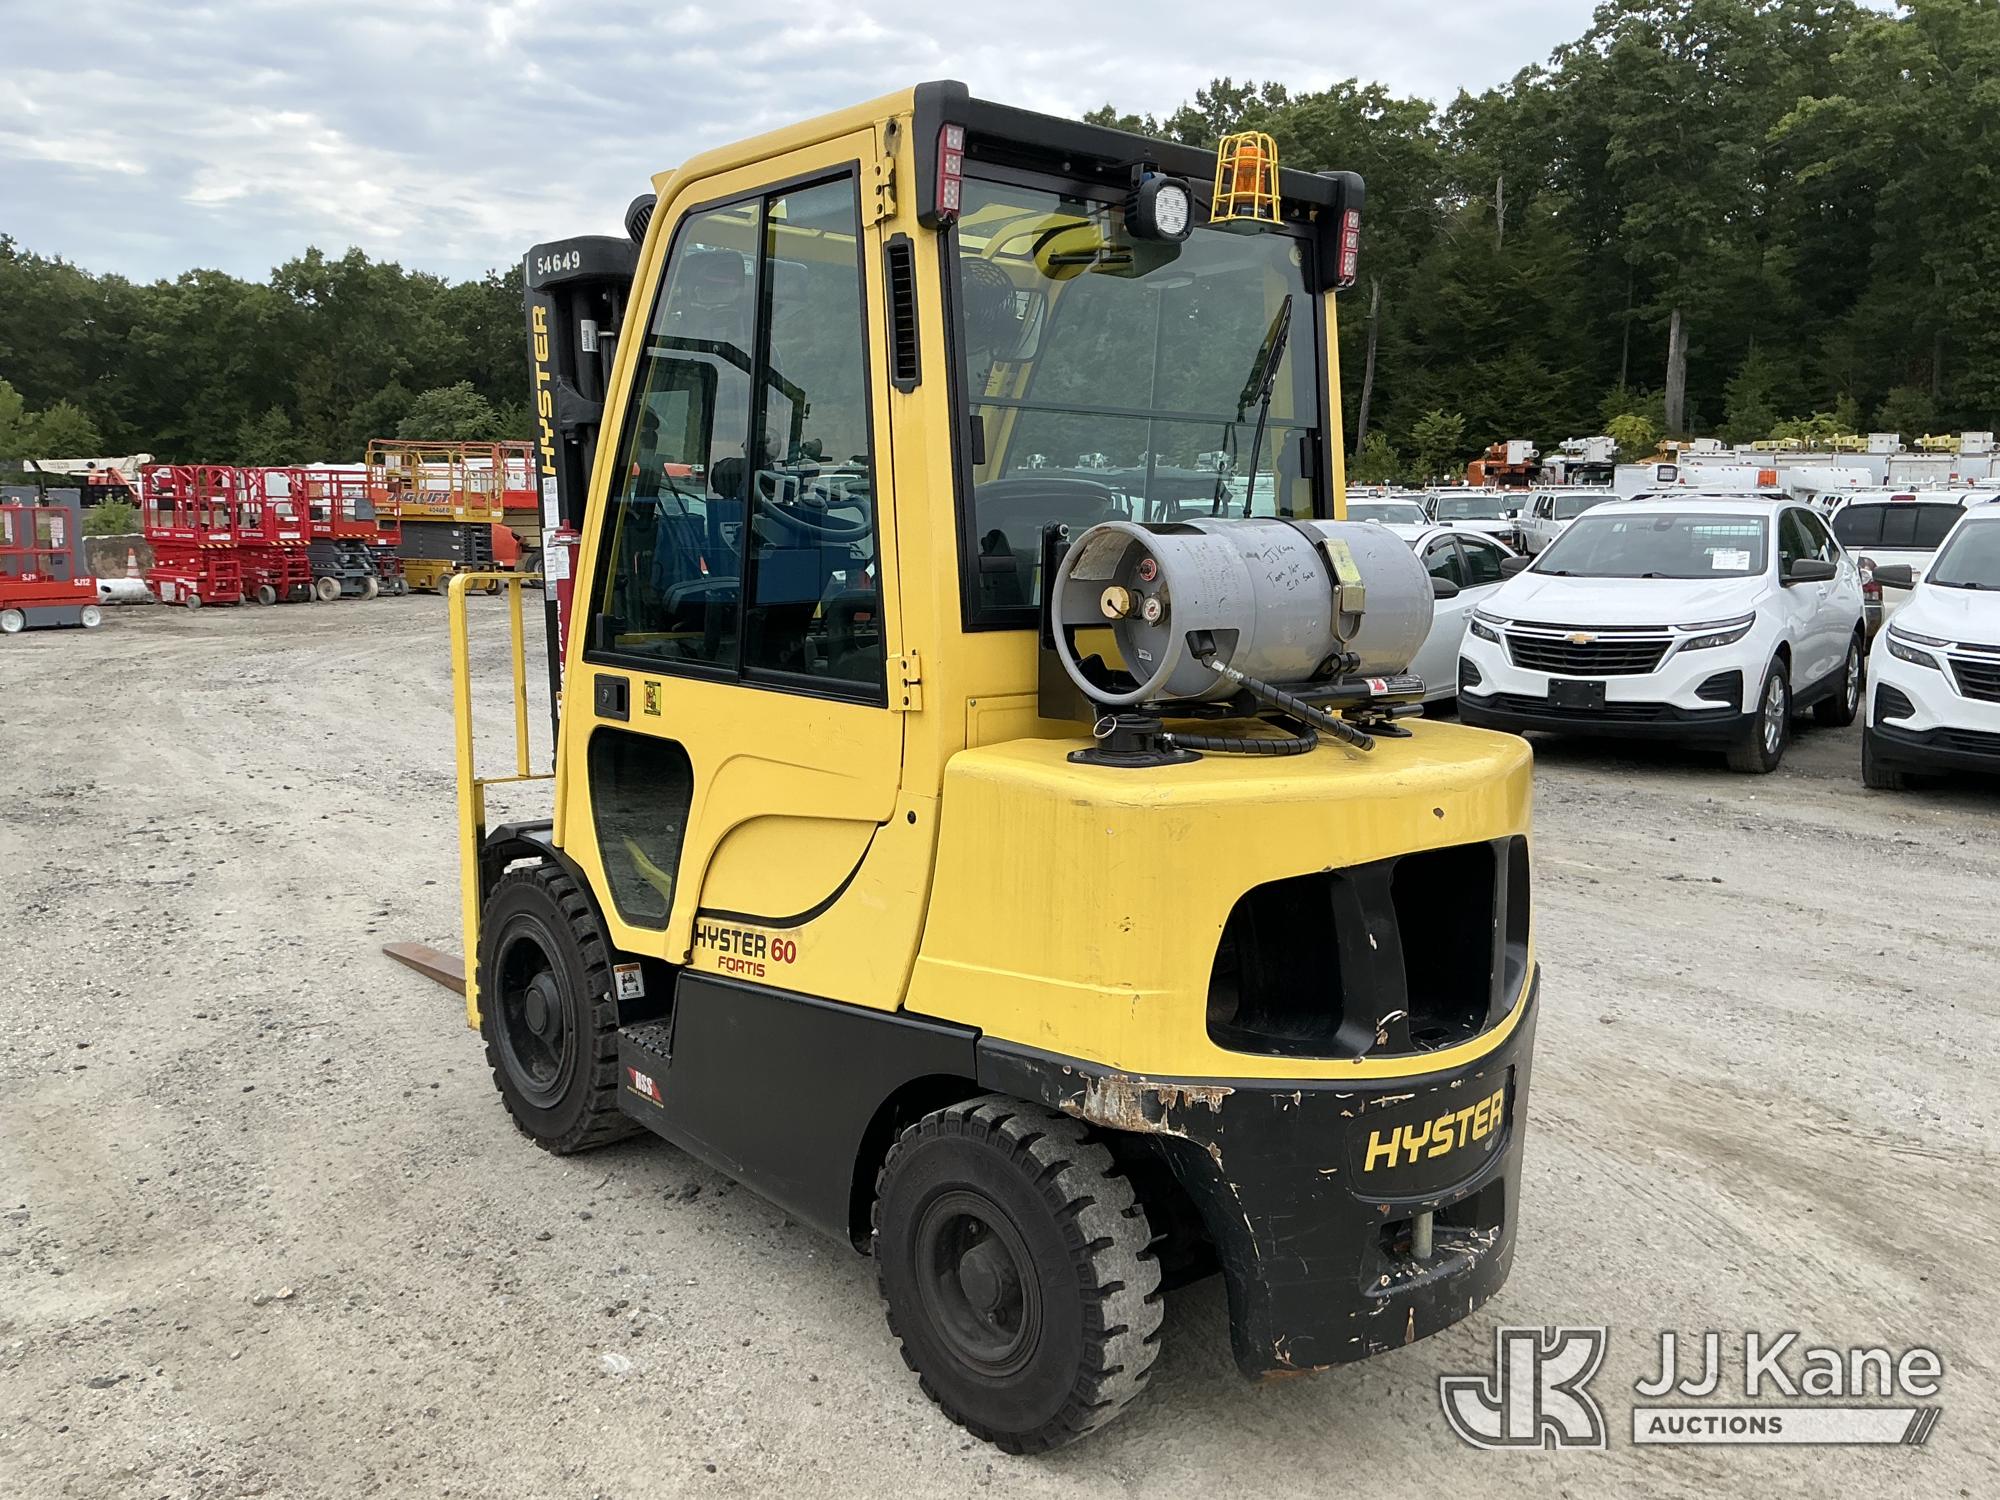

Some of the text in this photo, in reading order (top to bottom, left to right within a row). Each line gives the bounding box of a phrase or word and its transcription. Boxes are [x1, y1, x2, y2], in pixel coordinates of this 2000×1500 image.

[537, 250, 580, 276] 54649
[532, 305, 556, 475] HYSTER
[73, 578, 91, 586] SJ12
[694, 923, 797, 965] HYSTER 60
[718, 955, 766, 978] FORTIS
[635, 1070, 653, 1096] HSS
[1363, 1087, 1504, 1172] HYSTER
